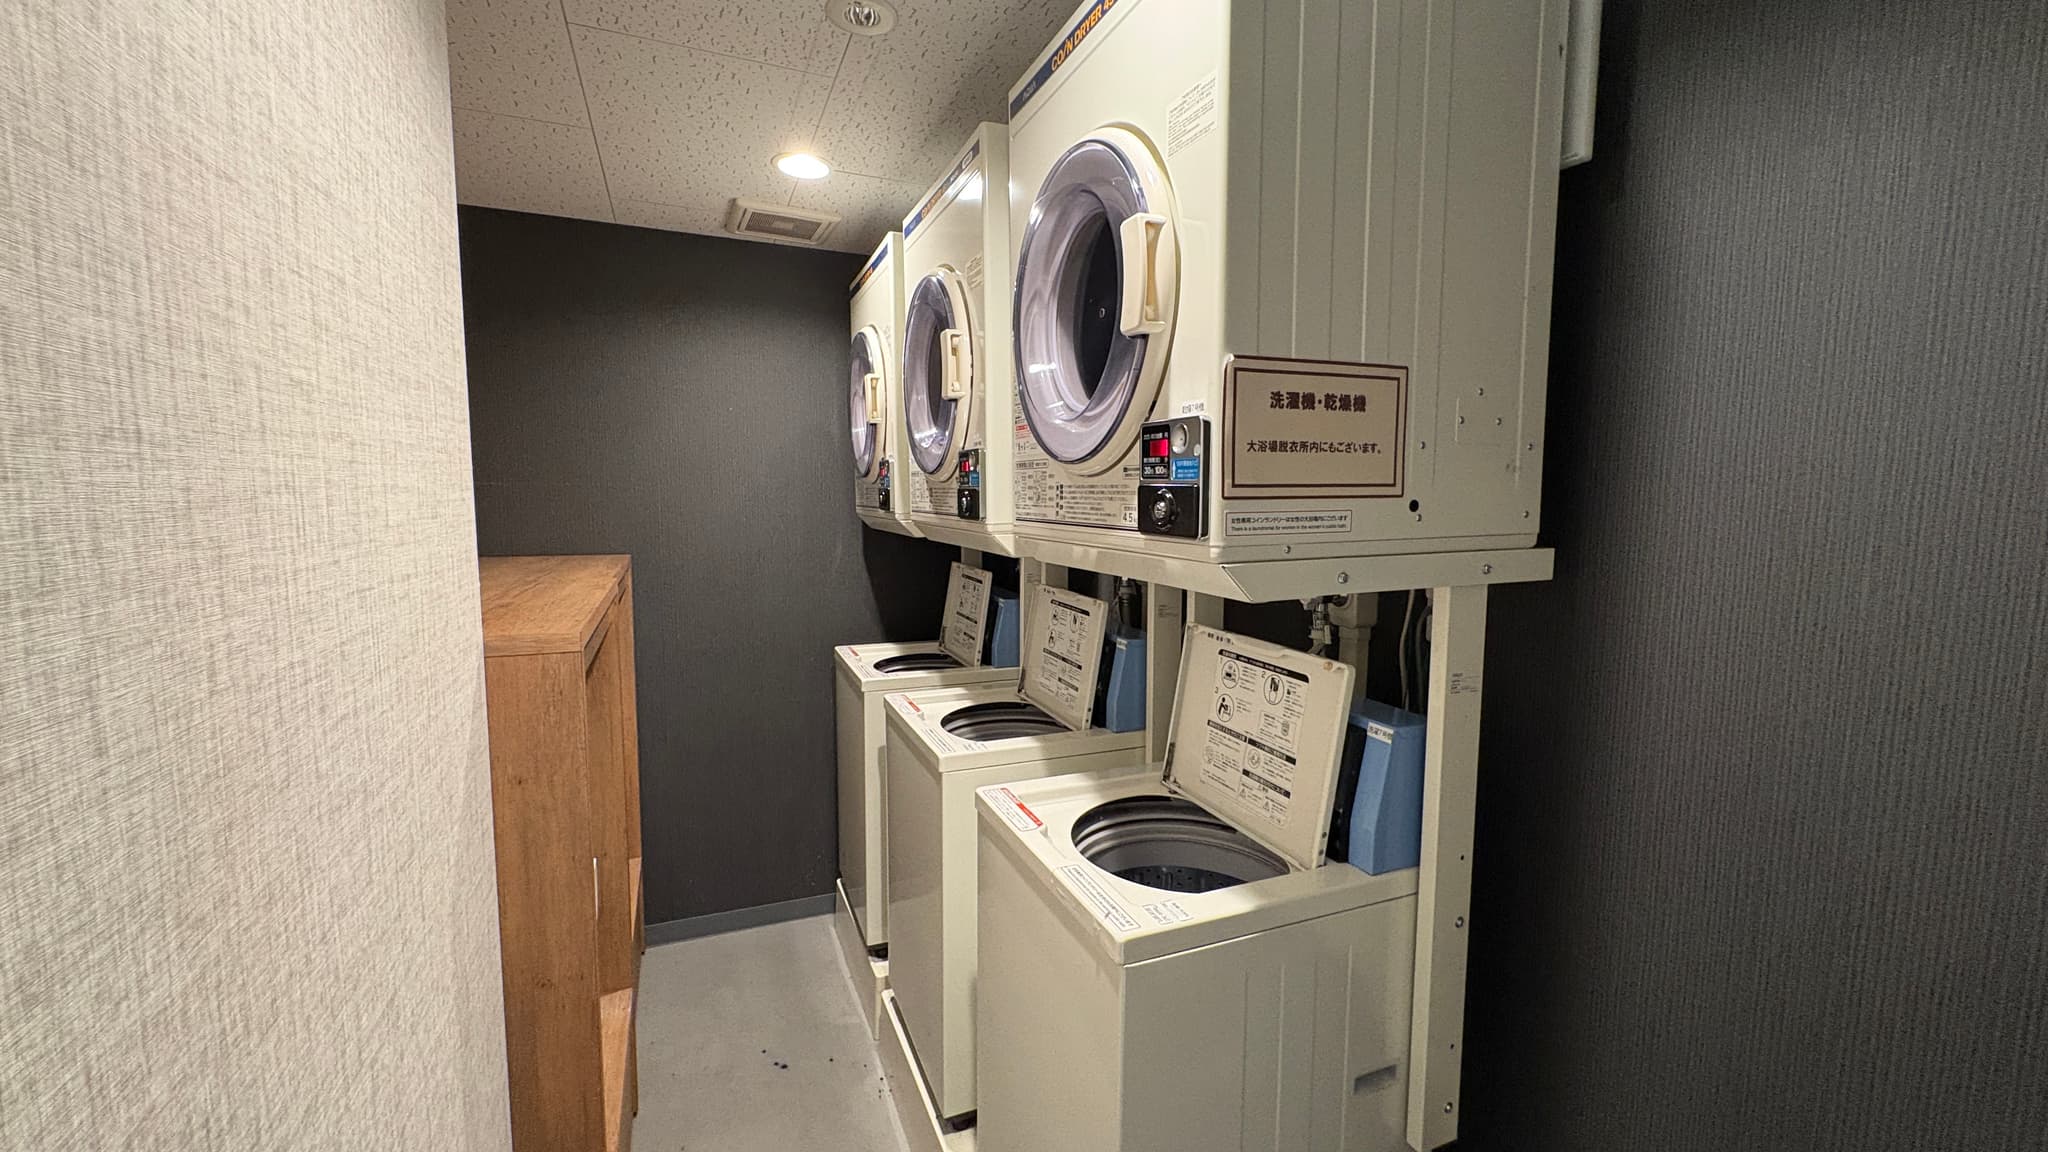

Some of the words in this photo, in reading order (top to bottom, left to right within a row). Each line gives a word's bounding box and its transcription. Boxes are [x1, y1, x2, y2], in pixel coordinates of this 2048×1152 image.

[1074, 4, 1102, 45] DRYER
[1270, 391, 1366, 412] 洗濯機・乾燥機
[1247, 440, 1382, 454] 大浴場脱衣所内にもございます。
